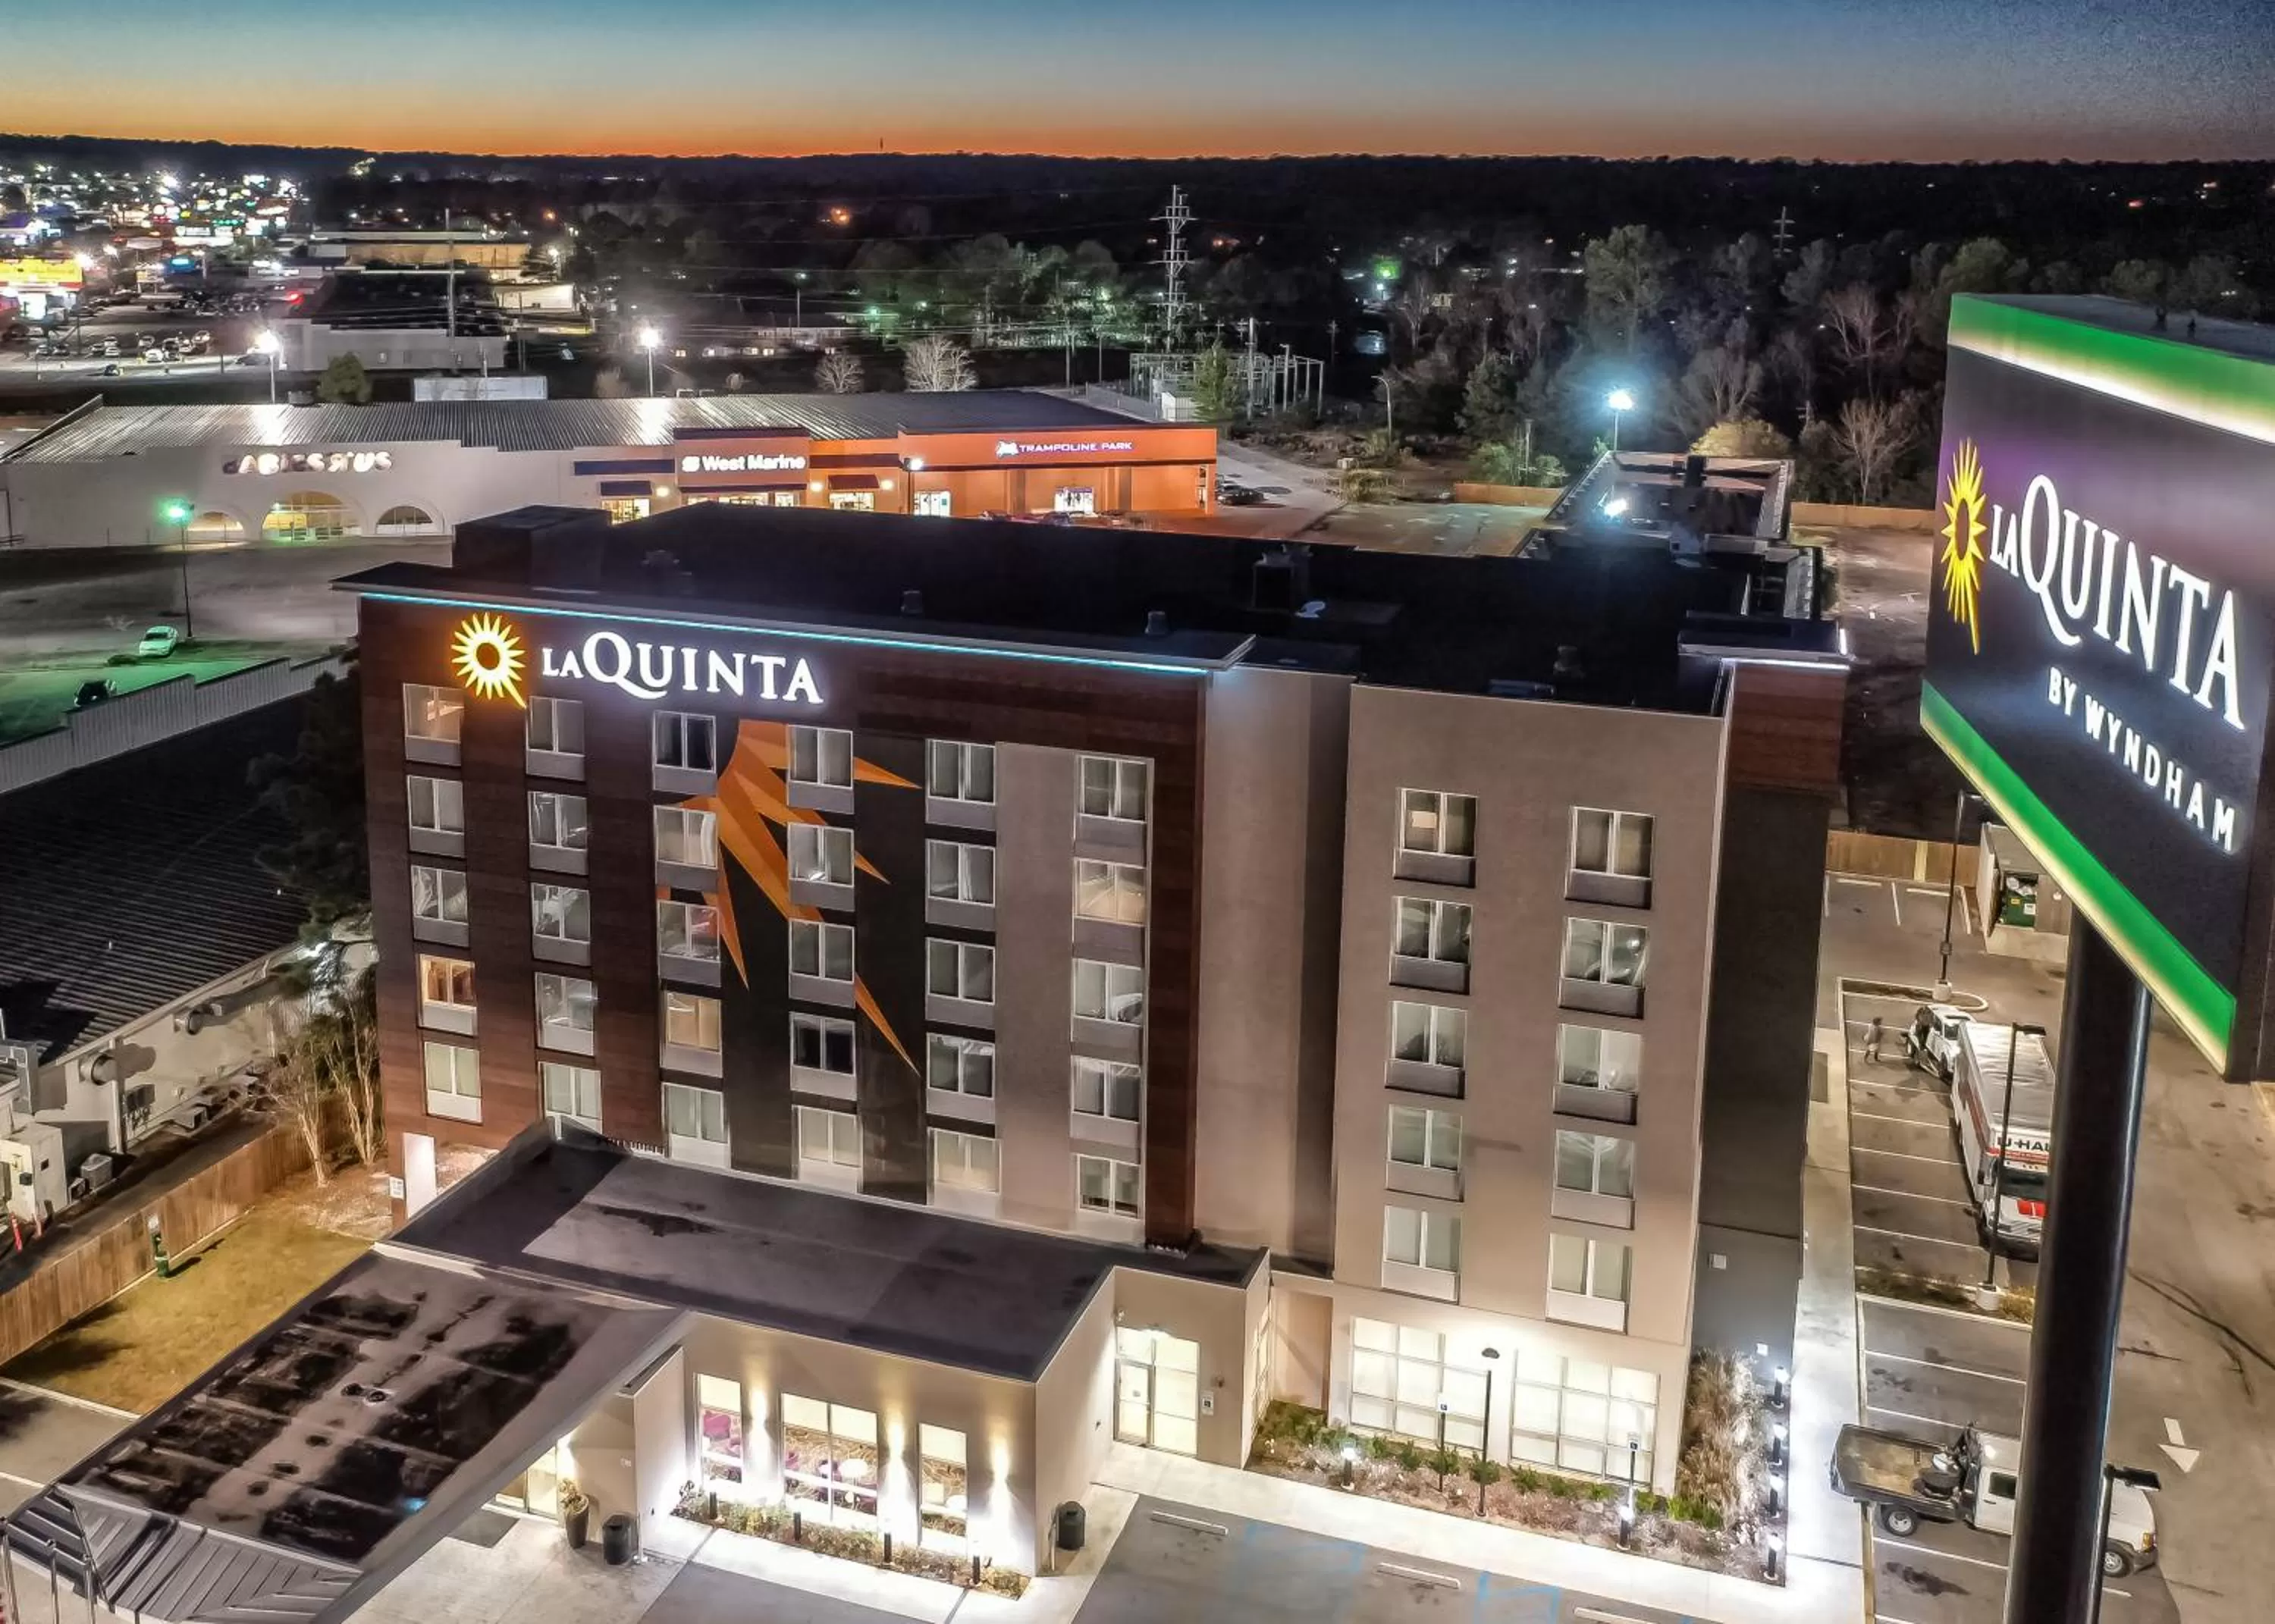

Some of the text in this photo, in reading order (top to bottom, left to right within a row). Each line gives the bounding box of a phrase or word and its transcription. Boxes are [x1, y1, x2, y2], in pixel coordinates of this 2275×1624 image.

[702, 454, 806, 472] West Marine
[1019, 441, 1132, 453] TRAMPOLINE PARK
[1990, 474, 2245, 731] LA QUINTA
[542, 631, 824, 704] LA QUINTA
[2048, 666, 2236, 852] BY WYNDHAM
[1997, 1137, 2051, 1152] U-HA
